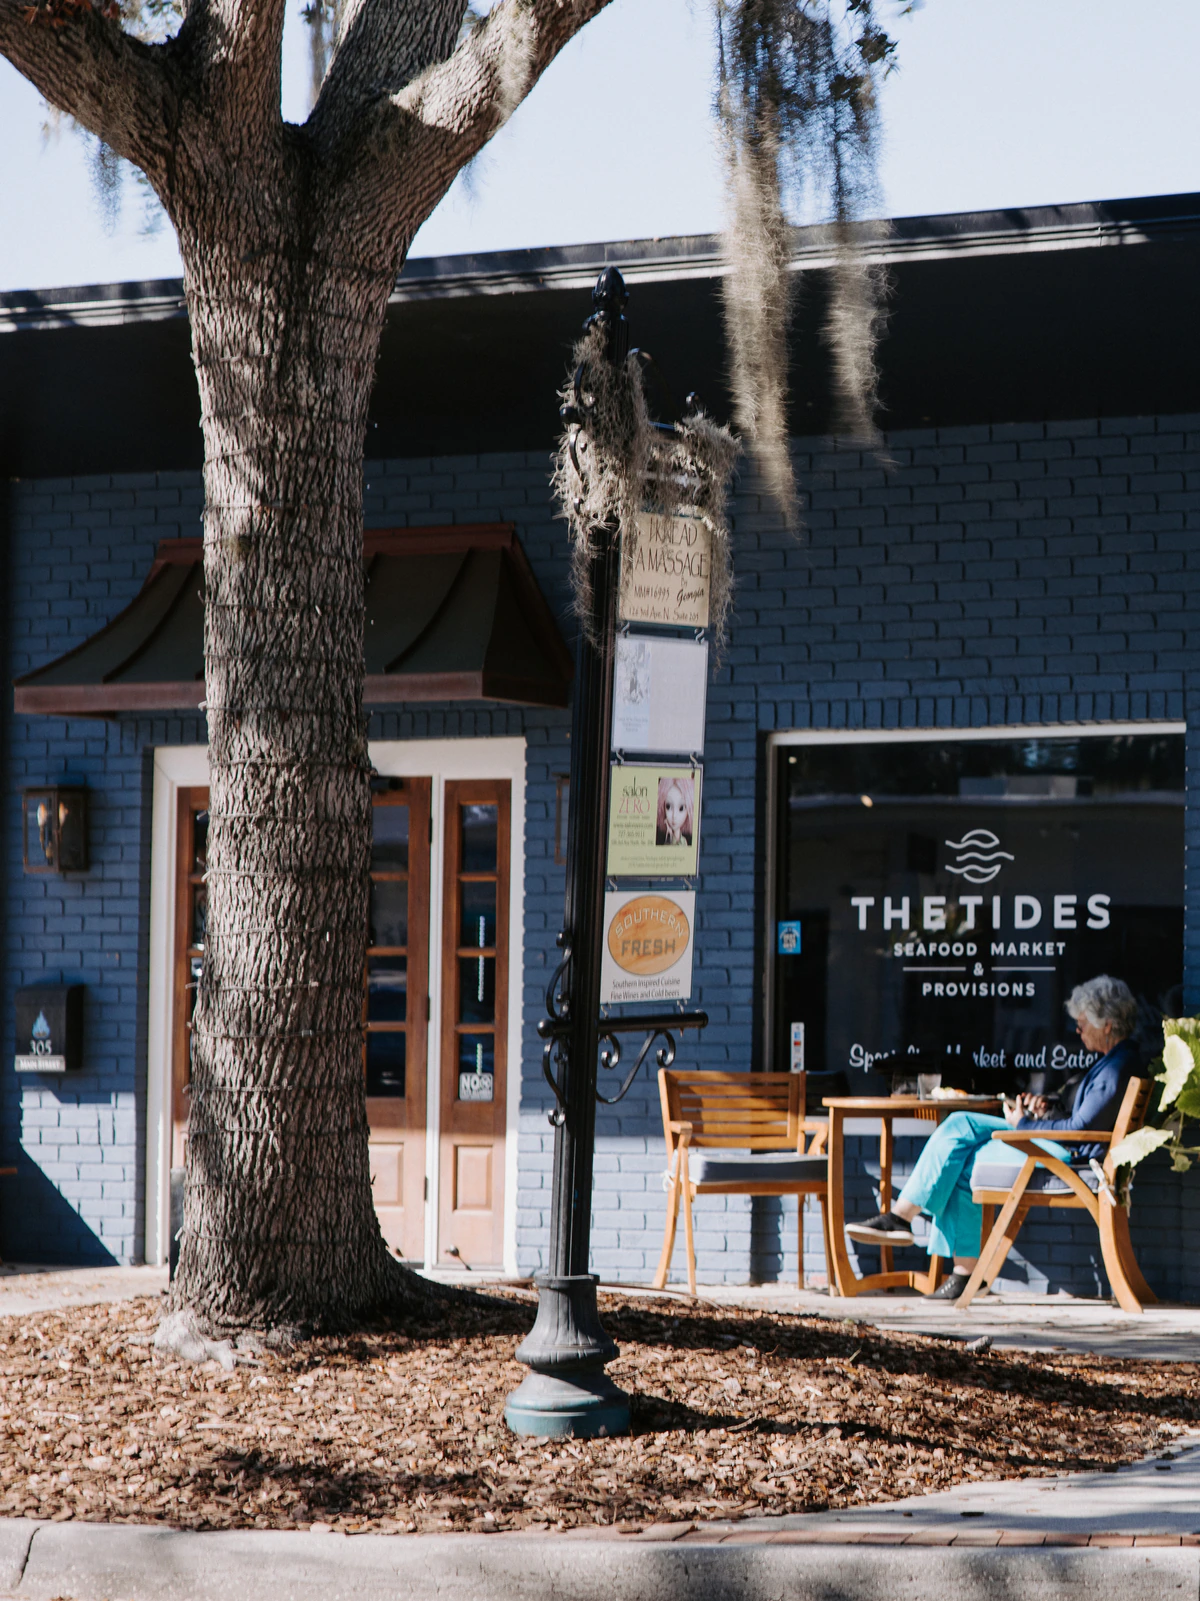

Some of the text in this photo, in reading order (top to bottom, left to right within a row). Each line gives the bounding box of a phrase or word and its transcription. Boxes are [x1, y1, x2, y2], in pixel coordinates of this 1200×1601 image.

[635, 546, 708, 579] A MASSAGE
[623, 776, 648, 797] salon
[618, 798, 651, 814] ZERO
[615, 908, 684, 938] SOUTHERN
[621, 939, 676, 956] FRESH
[893, 942, 1066, 957] SEAFOOD MARKET
[973, 962, 984, 976] &
[922, 982, 1036, 997] PROVISIONS
[29, 1039, 52, 1057] 305
[1013, 1044, 1047, 1069] and
